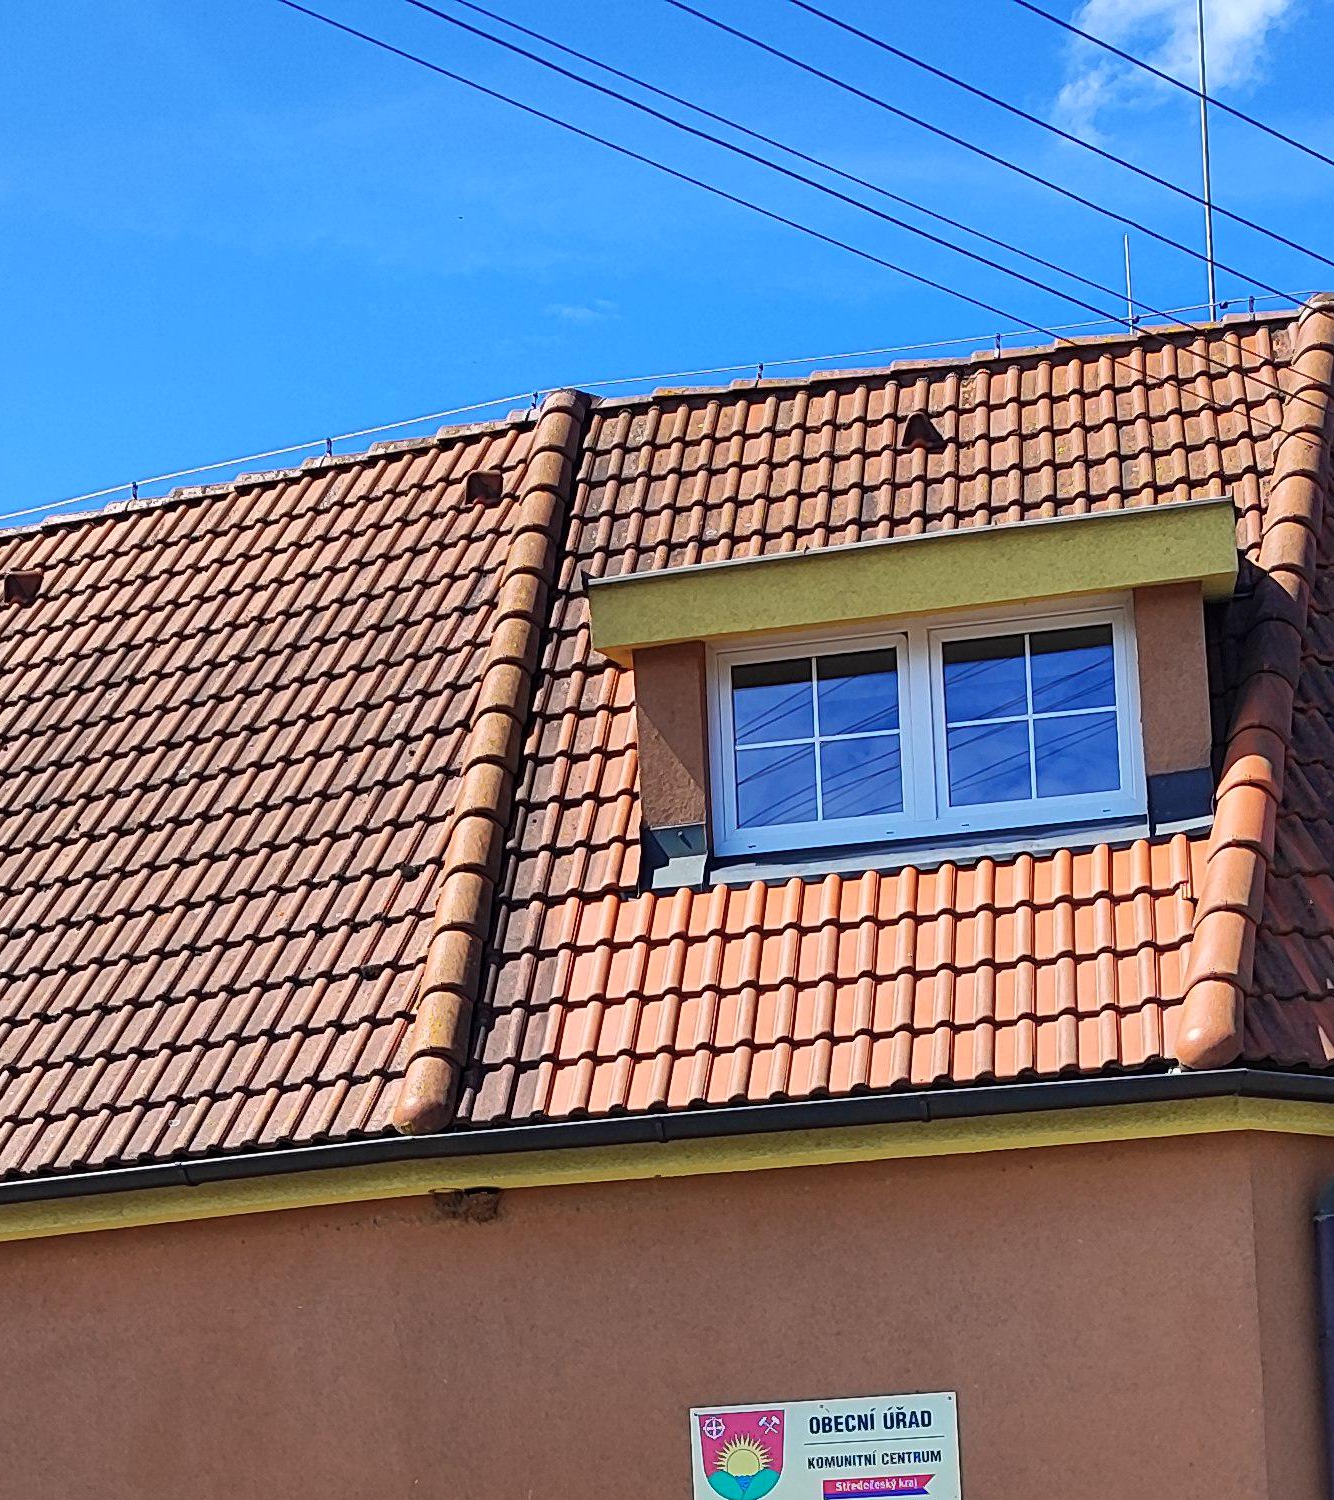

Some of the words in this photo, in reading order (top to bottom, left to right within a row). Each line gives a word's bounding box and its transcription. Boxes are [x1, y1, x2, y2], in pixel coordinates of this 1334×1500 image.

[809, 1407, 876, 1434] OBECNÍ
[883, 1406, 932, 1430] ÚŘAD
[807, 1450, 877, 1469] KOMUNITNÍ
[881, 1450, 942, 1465] CENTRUM
[898, 1478, 918, 1489] kraj
